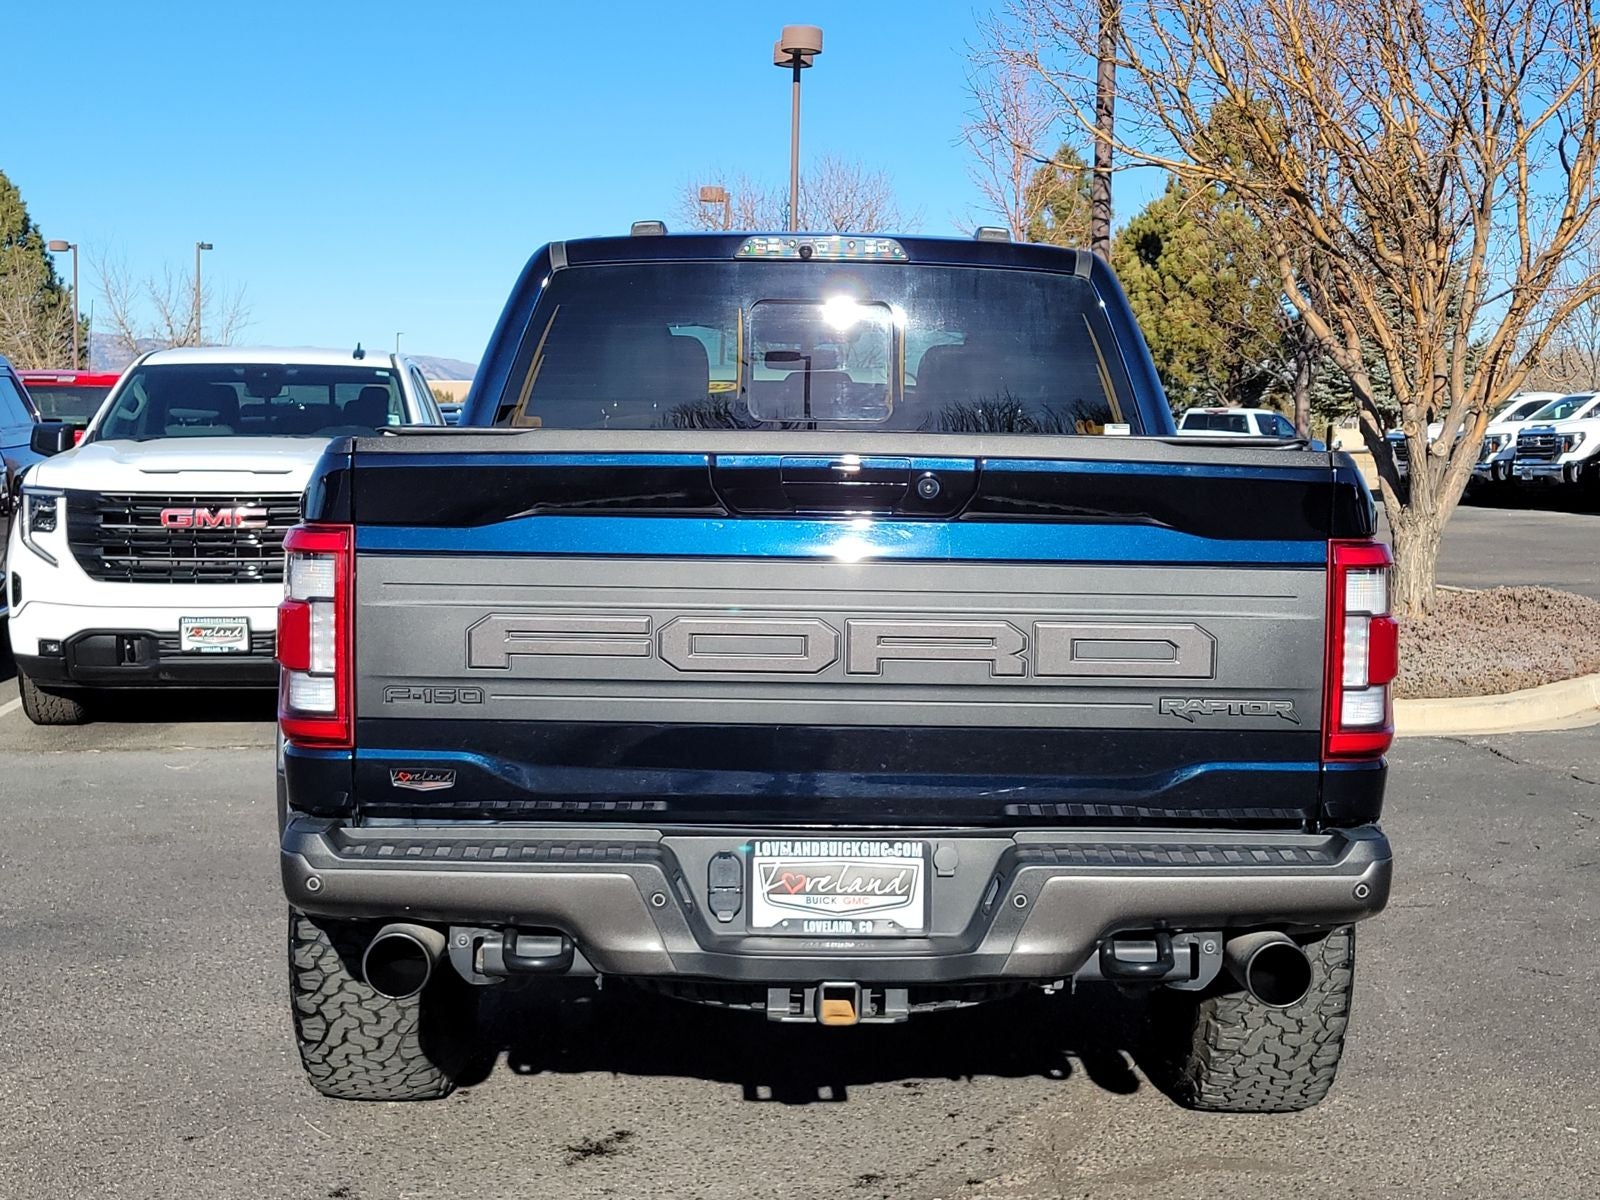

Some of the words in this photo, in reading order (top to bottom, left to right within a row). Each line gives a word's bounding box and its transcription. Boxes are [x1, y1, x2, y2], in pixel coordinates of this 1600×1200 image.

[160, 507, 268, 529] GMC
[466, 613, 1217, 679] FORD
[383, 685, 485, 704] F-150
[1159, 698, 1301, 726] RAPTOR
[754, 841, 923, 857] LOVELANDBUICKGMC.COM
[805, 896, 837, 905] BUICK
[843, 896, 870, 905] GMC
[860, 920, 873, 932] CO
